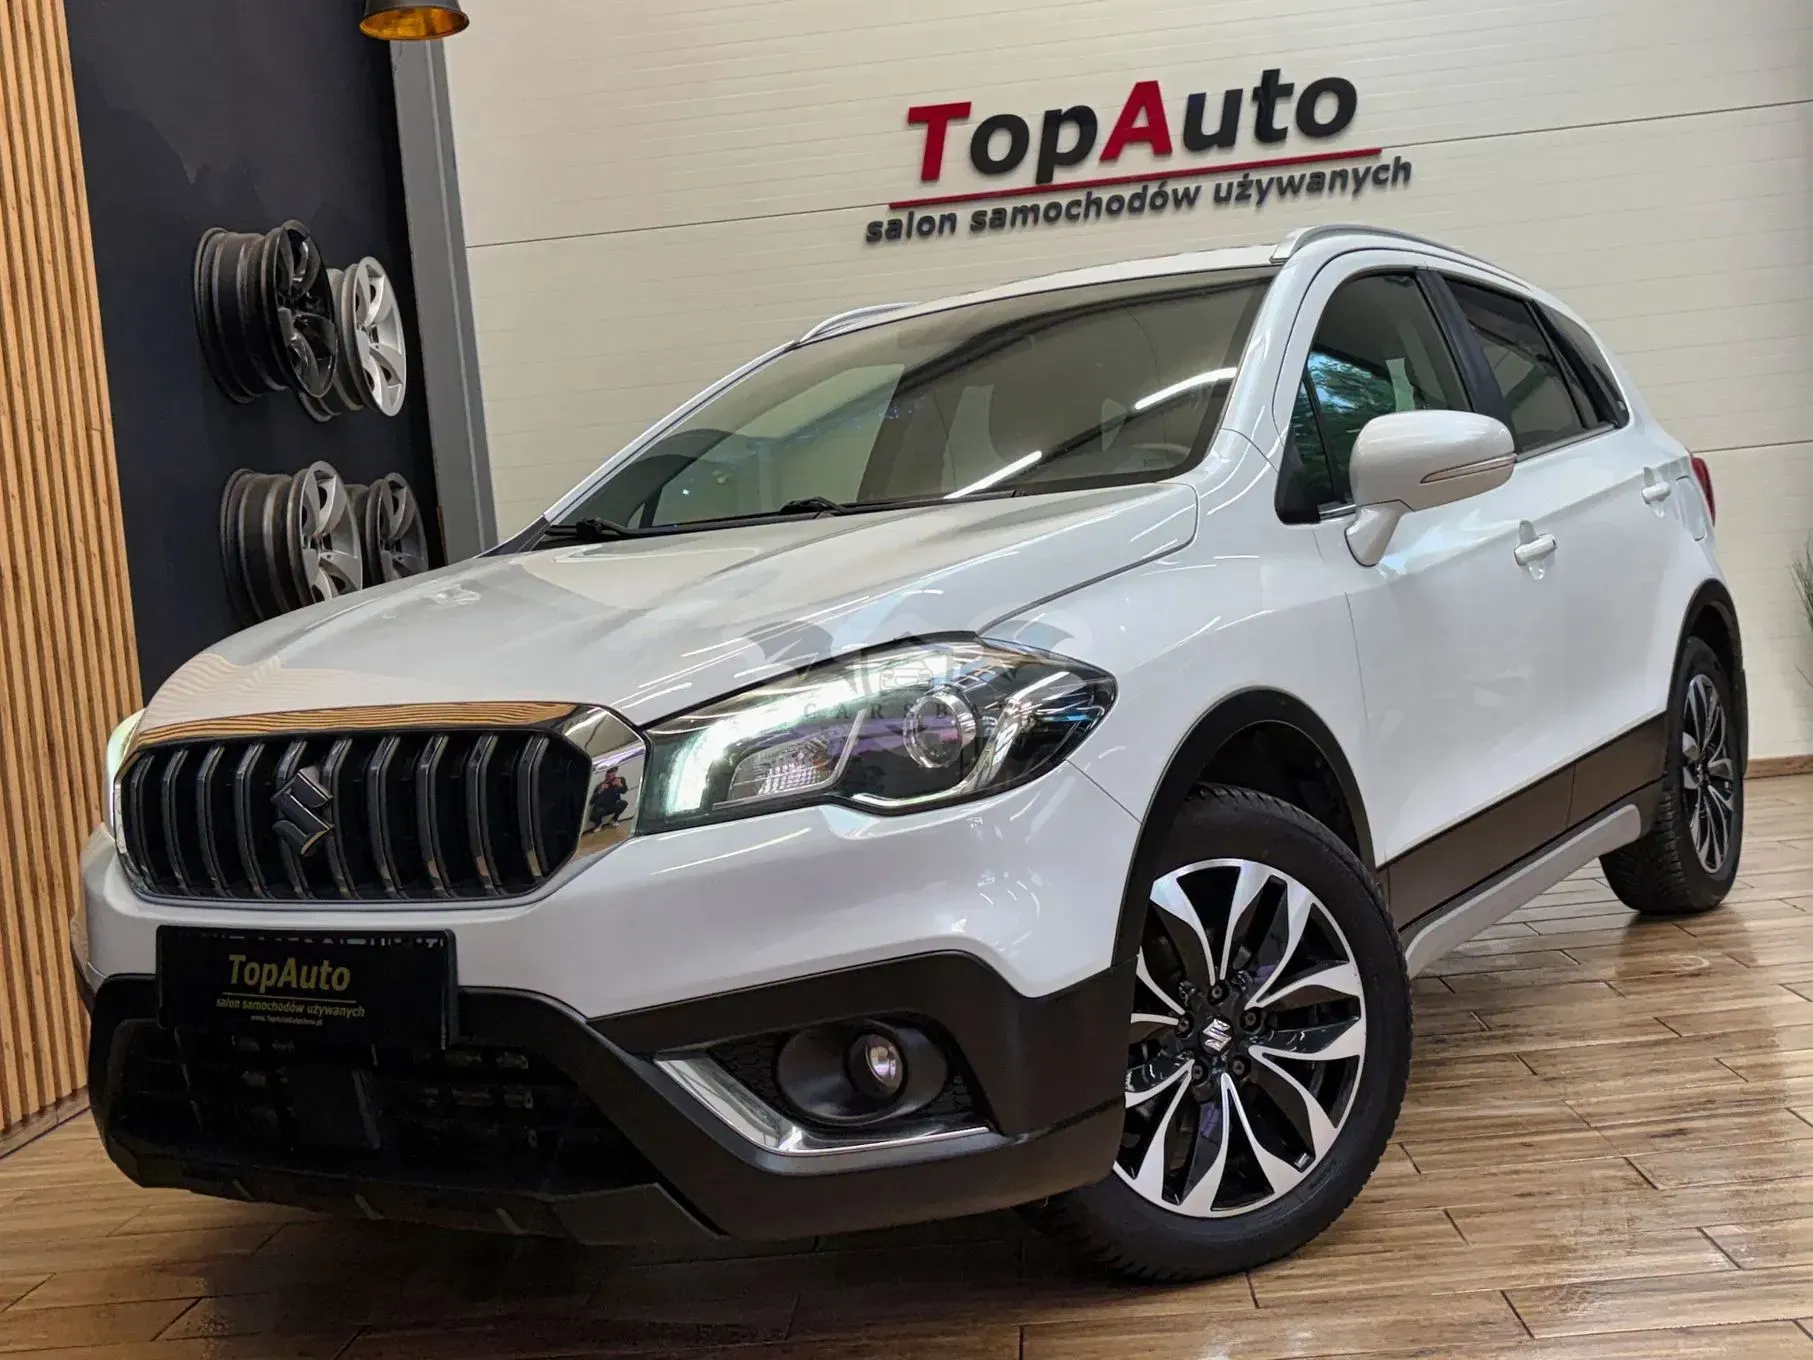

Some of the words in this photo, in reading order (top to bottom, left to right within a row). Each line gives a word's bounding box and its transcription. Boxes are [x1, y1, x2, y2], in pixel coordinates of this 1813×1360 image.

[907, 68, 1358, 184] TopAuto
[866, 210, 956, 242] salon
[969, 181, 1202, 233] samochodów
[1213, 156, 1412, 207] używanych
[229, 954, 351, 993] TopAuto
[216, 997, 240, 1008] salon
[242, 1000, 305, 1014] samochodów
[307, 1004, 366, 1021] używanych
